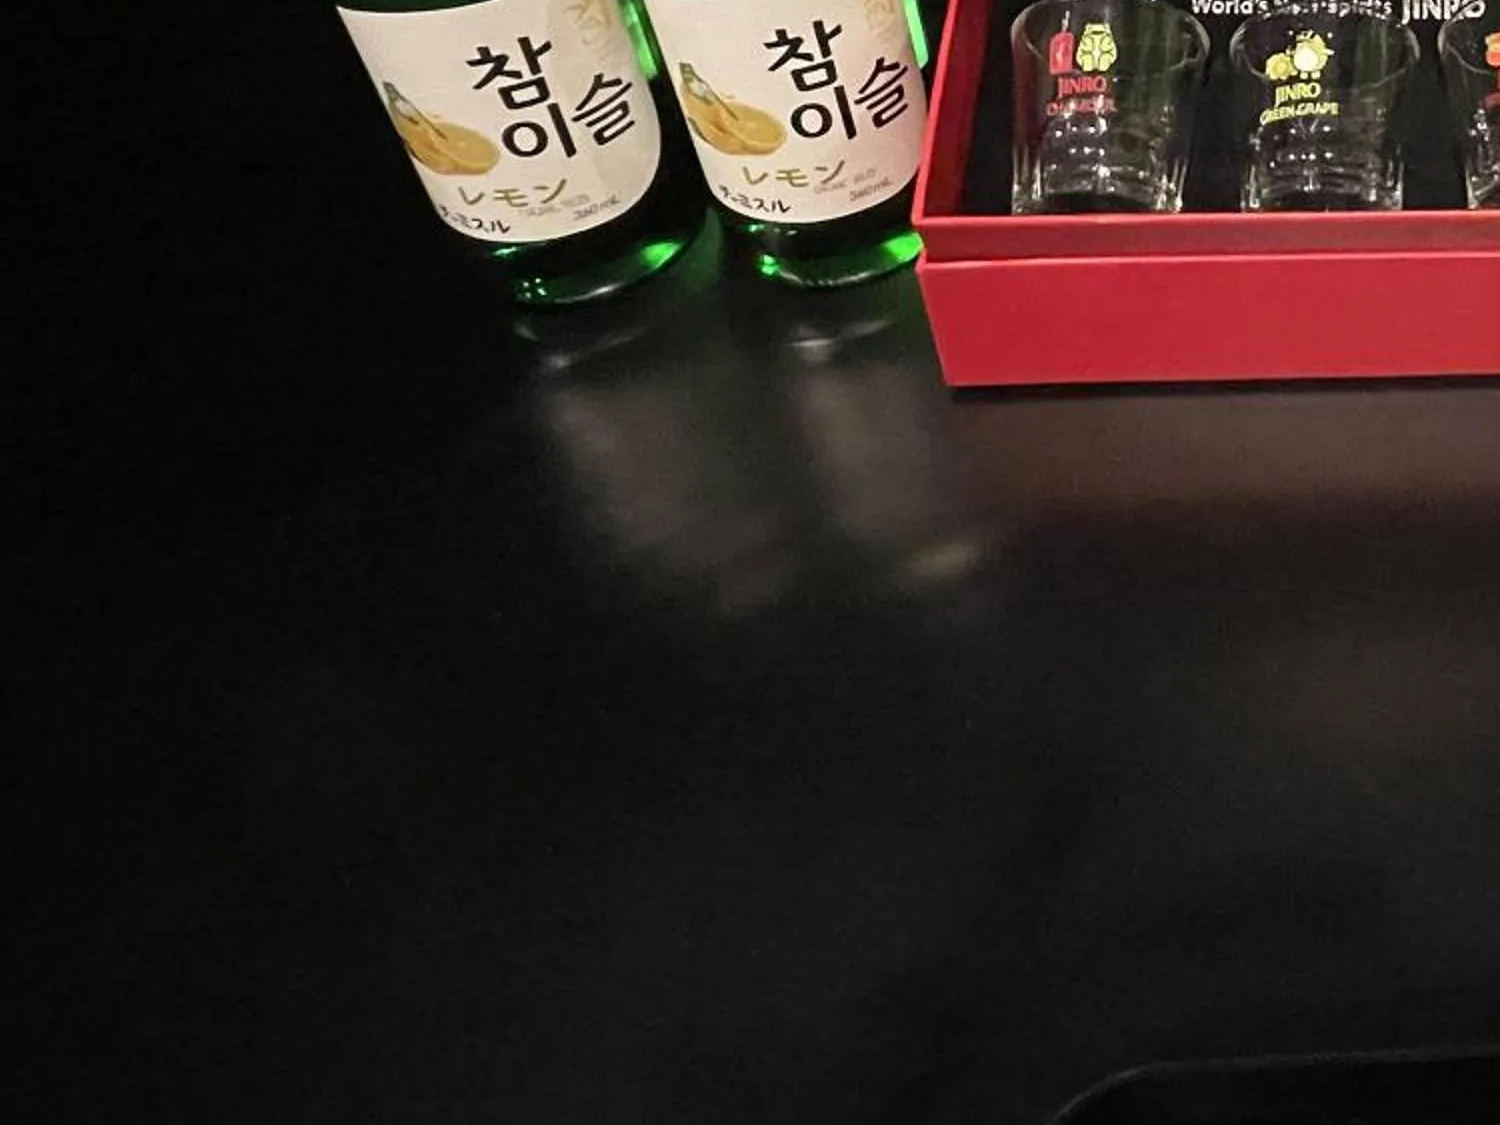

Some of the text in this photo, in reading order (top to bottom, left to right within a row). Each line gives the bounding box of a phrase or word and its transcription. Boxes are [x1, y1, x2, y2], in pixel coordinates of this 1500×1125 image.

[1058, 75, 1107, 98] JINRO
[1275, 82, 1321, 108] JINRO
[742, 160, 845, 187] レモン
[458, 178, 567, 207] レモン
